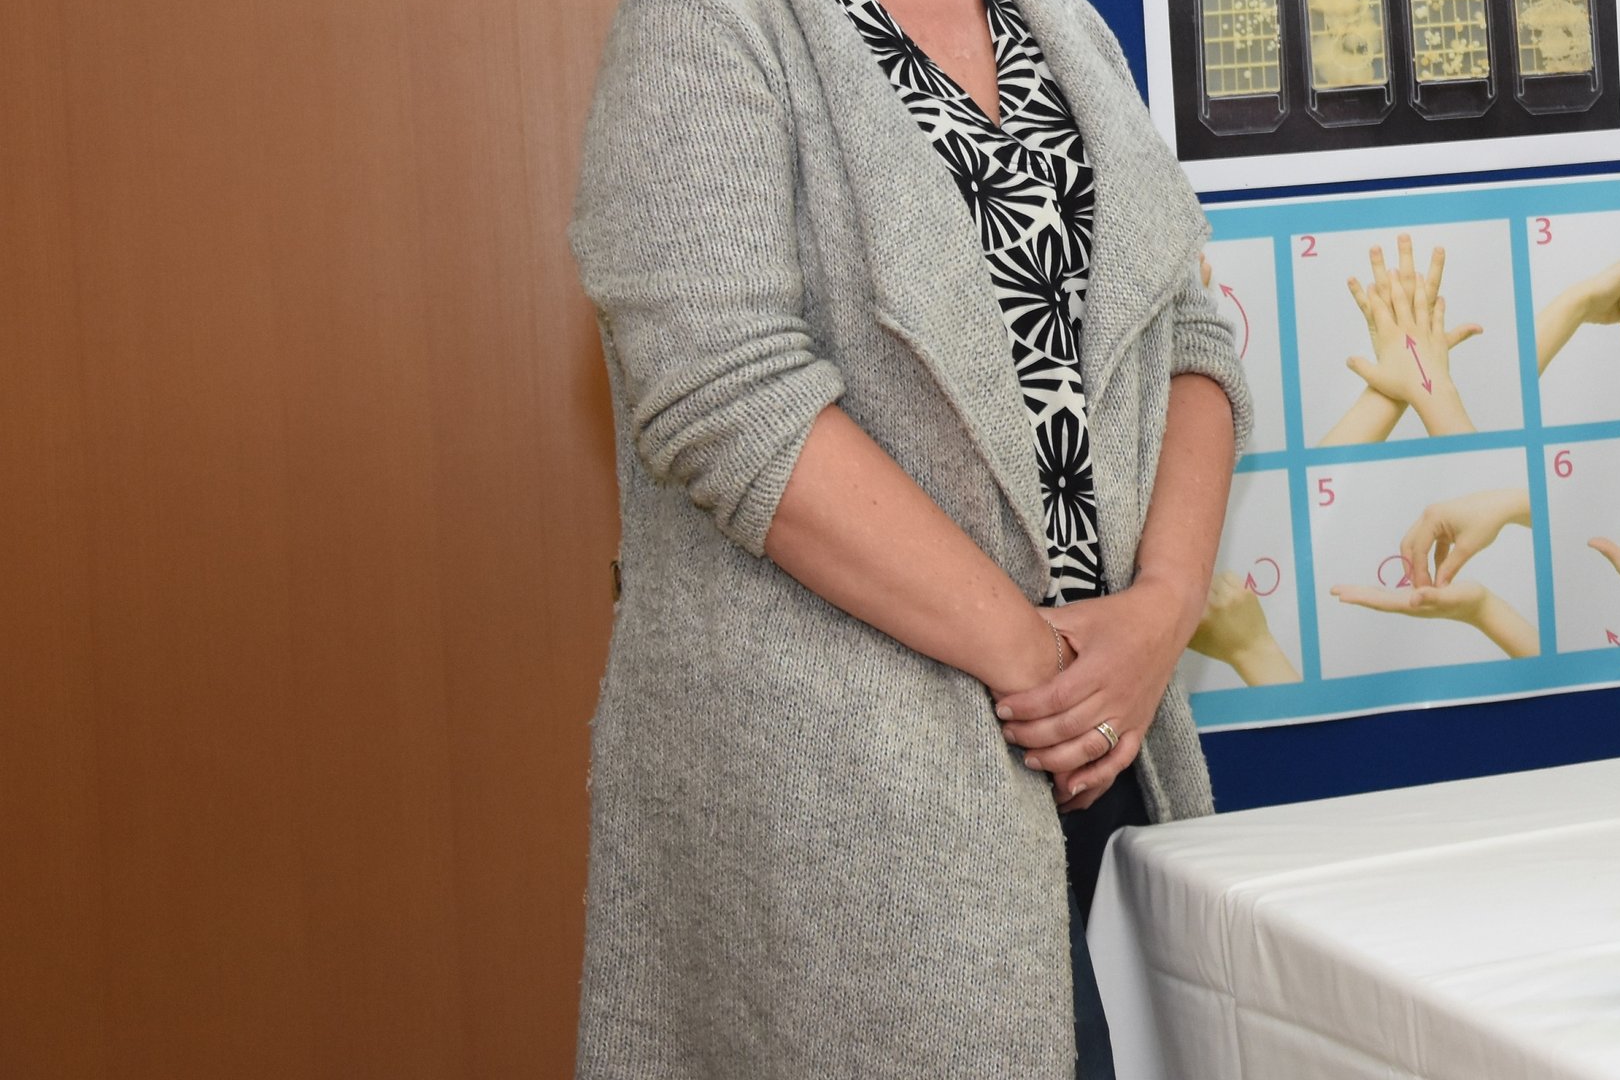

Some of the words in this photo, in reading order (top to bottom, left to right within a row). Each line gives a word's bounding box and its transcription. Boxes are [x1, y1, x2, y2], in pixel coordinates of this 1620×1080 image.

[1534, 217, 1554, 246] 3
[1298, 235, 1319, 258] 2
[1552, 450, 1574, 479] 6
[1316, 478, 1336, 507] 5
